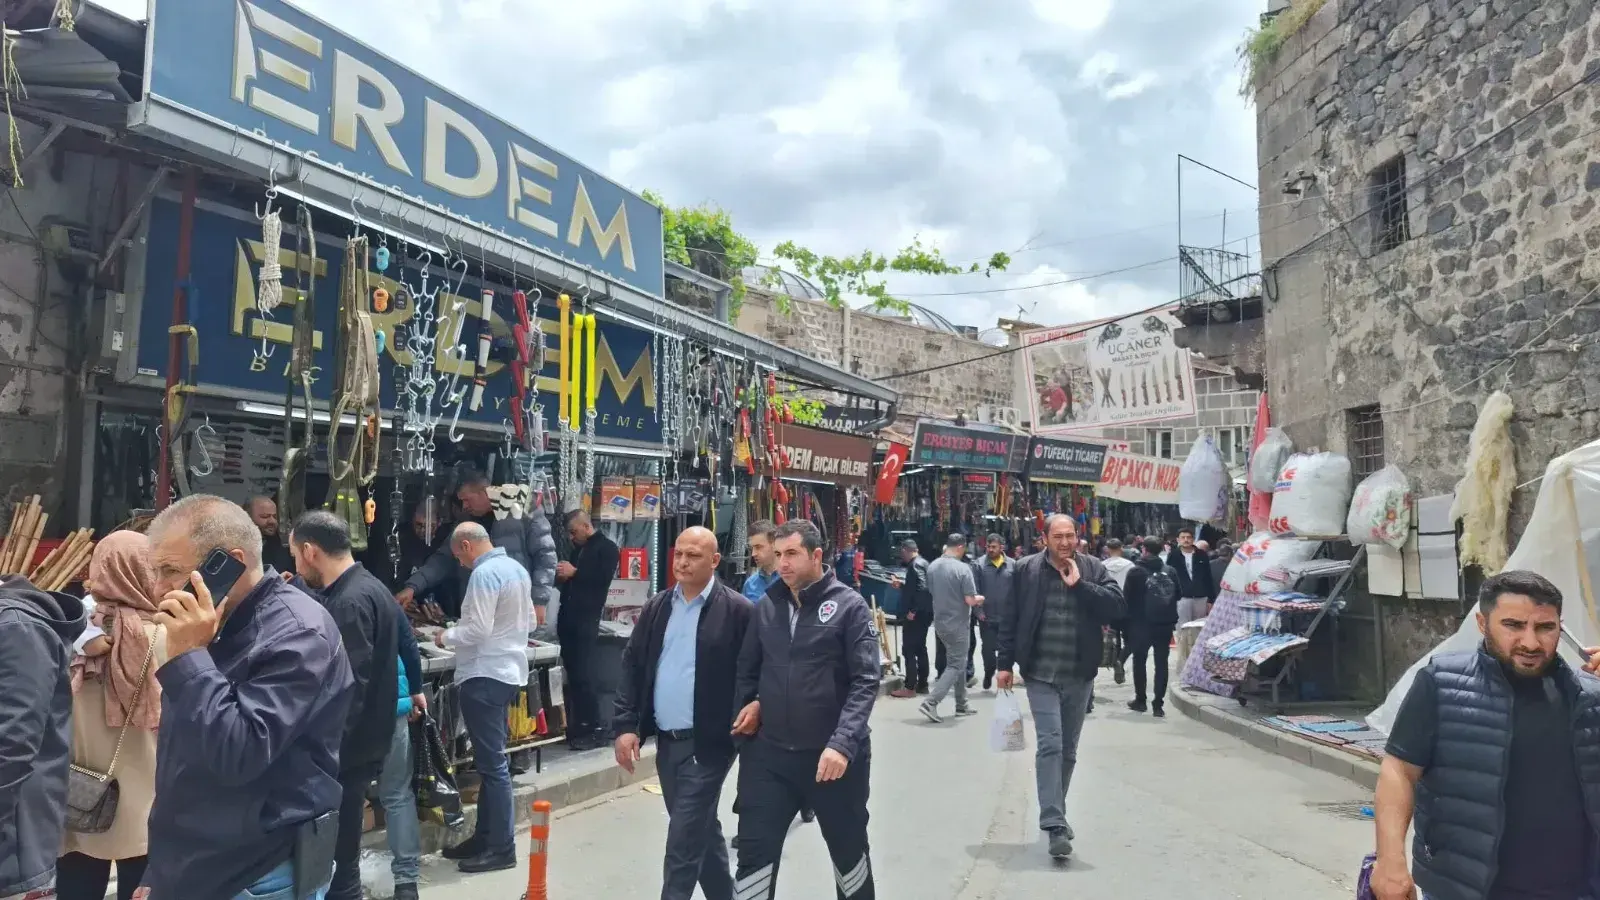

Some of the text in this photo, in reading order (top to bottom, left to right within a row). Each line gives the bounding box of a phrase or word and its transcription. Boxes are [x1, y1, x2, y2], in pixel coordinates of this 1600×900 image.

[230, 0, 637, 272] ERDEM
[1108, 336, 1162, 356] UÇANER
[1043, 444, 1075, 464] TÜFEKÇİ
[1075, 446, 1105, 465] TİCARET
[812, 455, 840, 476] BIÇAK
[840, 456, 869, 477] BİLEME
[1153, 463, 1180, 492] MUR
